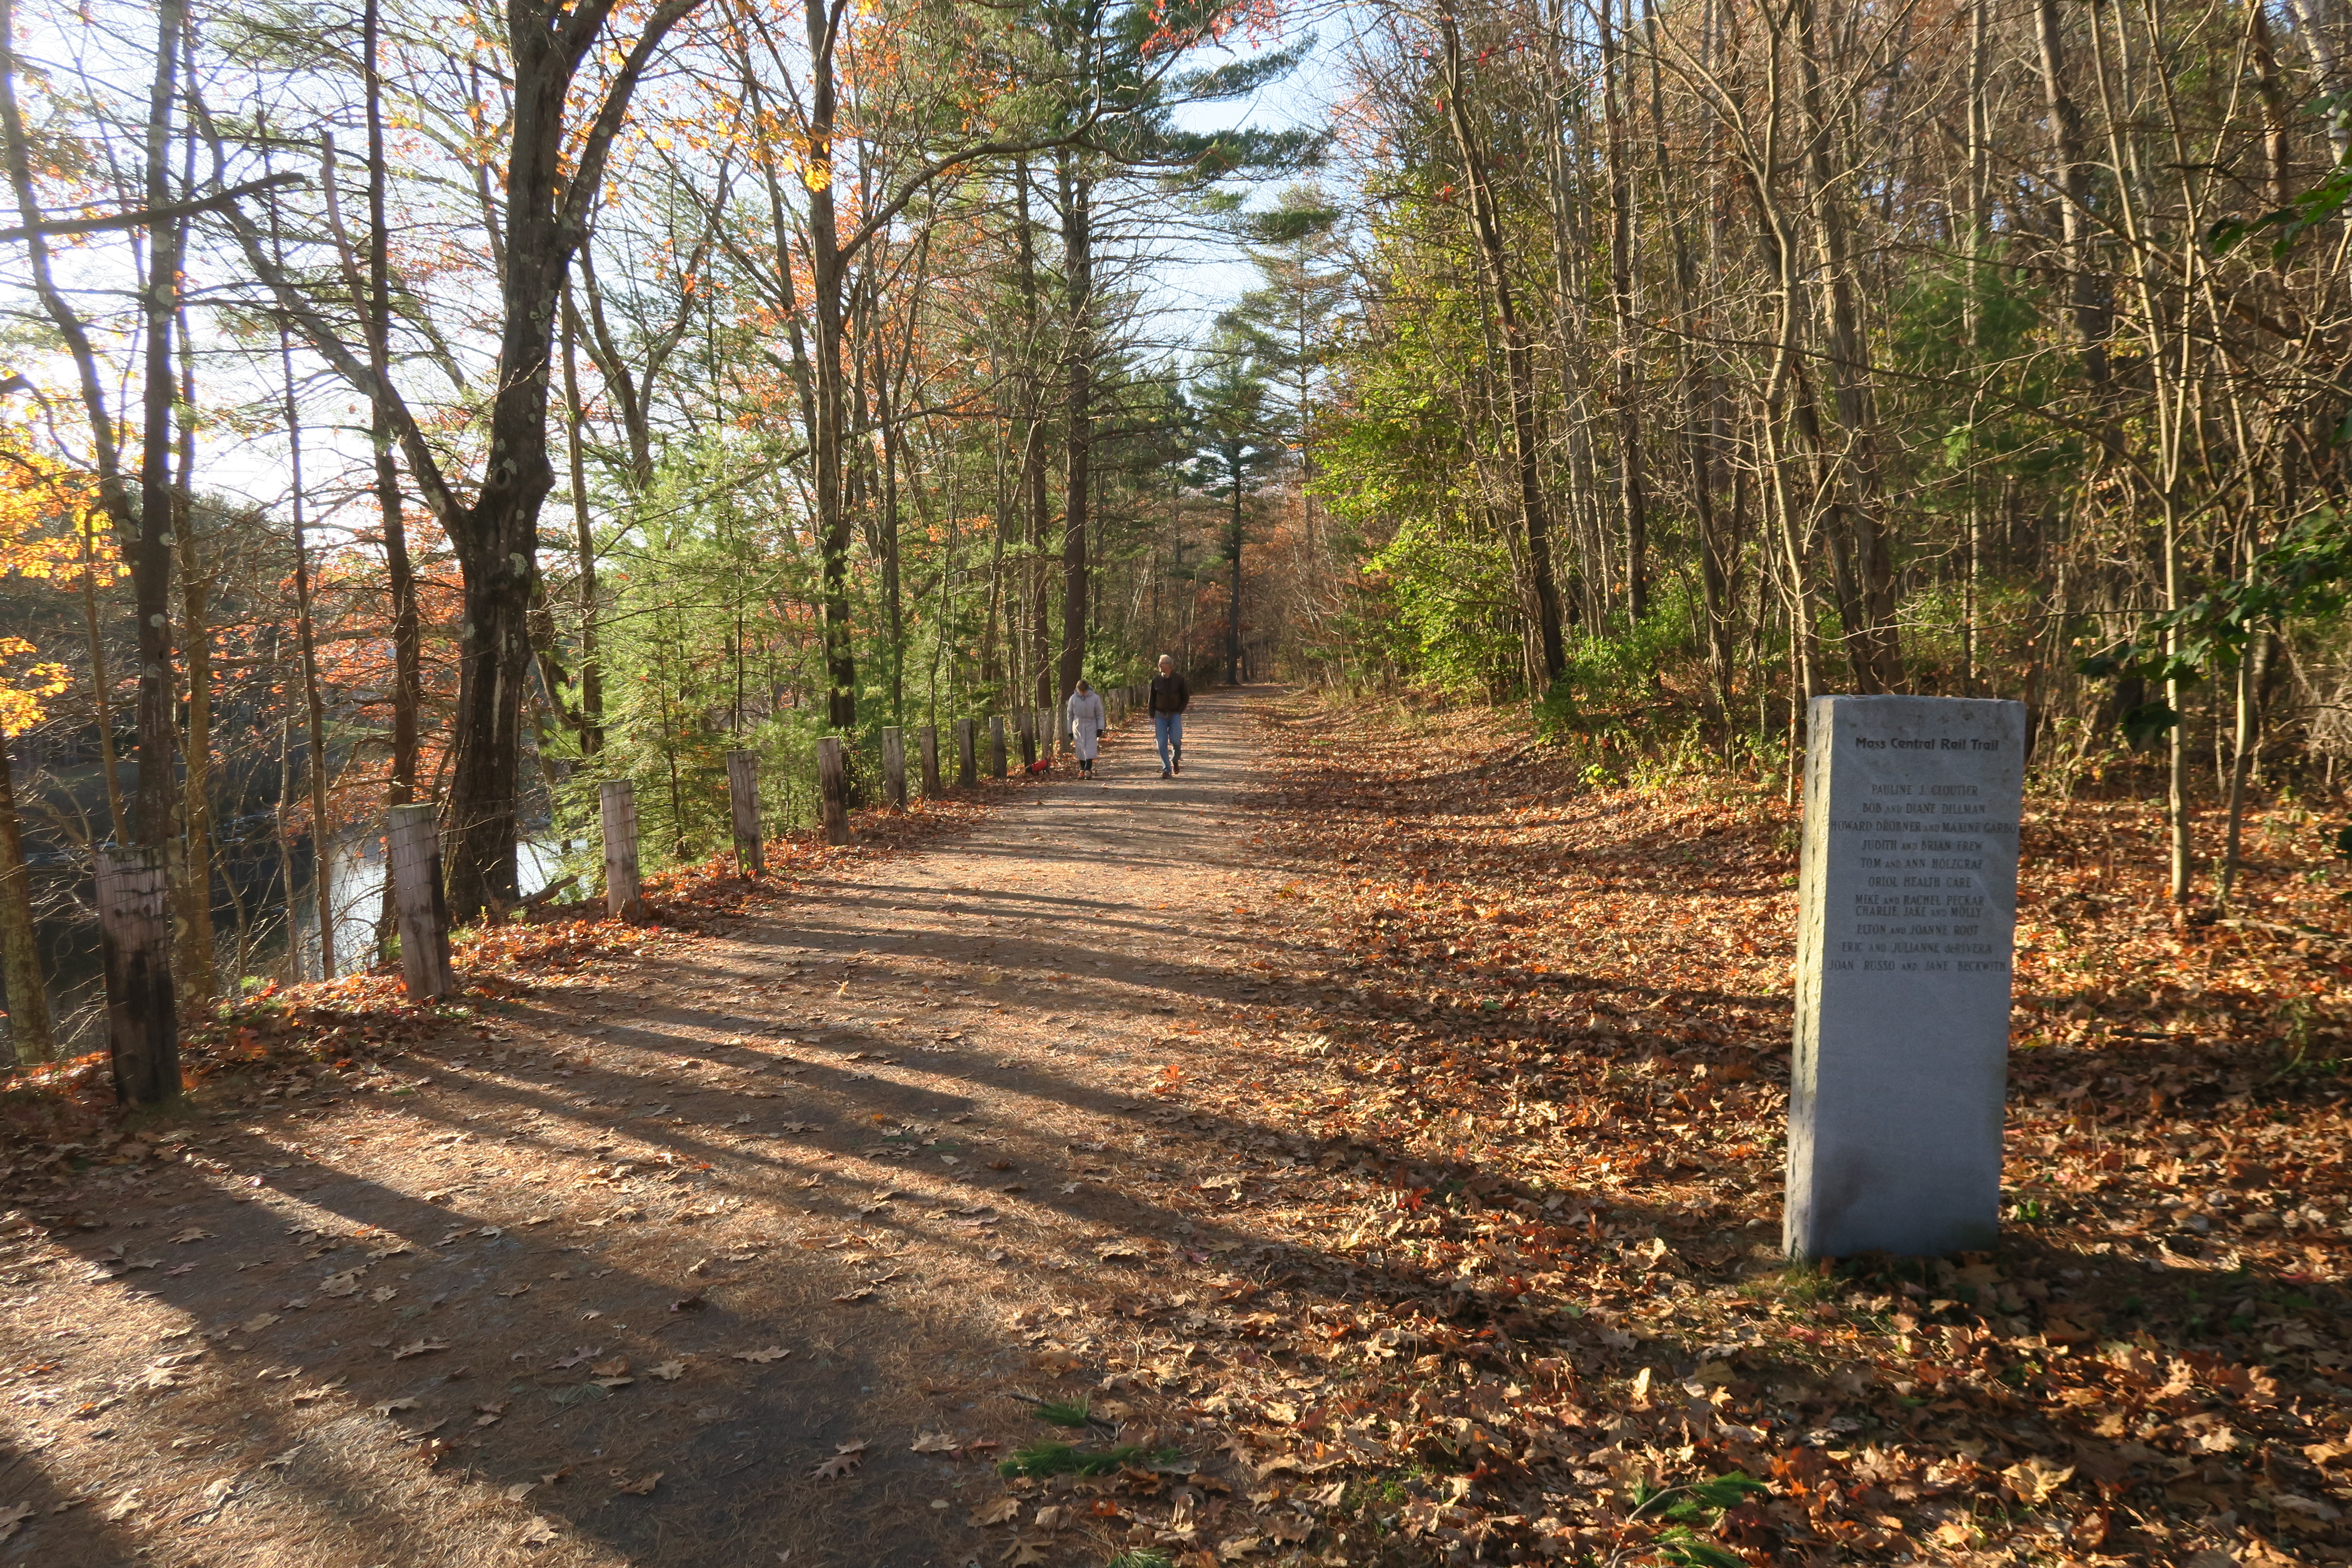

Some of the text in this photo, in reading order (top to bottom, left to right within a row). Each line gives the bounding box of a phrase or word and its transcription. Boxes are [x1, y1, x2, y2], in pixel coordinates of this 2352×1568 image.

[1856, 738, 1999, 750] Mass Central Rail Trail
[1872, 784, 1911, 795] PAULINE
[1931, 785, 1977, 796] CLOUTIER
[1863, 803, 1882, 813] BOB
[1906, 803, 1936, 813] DIANE
[1942, 804, 1985, 814] DILLMAN
[1831, 821, 1872, 831] HOWARD
[1942, 822, 1980, 833] MAXINE
[1862, 840, 1896, 850] JUDITH
[1920, 841, 1951, 851] BRIAN
[1861, 858, 1881, 868] TOM
[1905, 859, 1925, 869] ANN
[1868, 876, 1971, 888] ORIOL HEALTH CARE
[1855, 894, 1879, 904] MIKE
[1883, 897, 1900, 905] AND
[1903, 895, 1940, 905] RACHEL
[1904, 906, 1926, 916] JAKE
[1931, 909, 1947, 917] AND
[1950, 907, 1981, 917] MOLLY
[1857, 924, 1886, 934] ELTON
[1910, 925, 1947, 935] JOANNE
[1954, 925, 1978, 936] ROOT
[1842, 942, 1862, 952] ERIC
[1869, 944, 1886, 952] AND
[1892, 943, 1939, 953] JULIANNE
[1828, 960, 1854, 970] JOAN
[1864, 961, 1895, 971] RUSSO
[1902, 963, 1917, 971] AND
[1925, 961, 1948, 971] JANE
